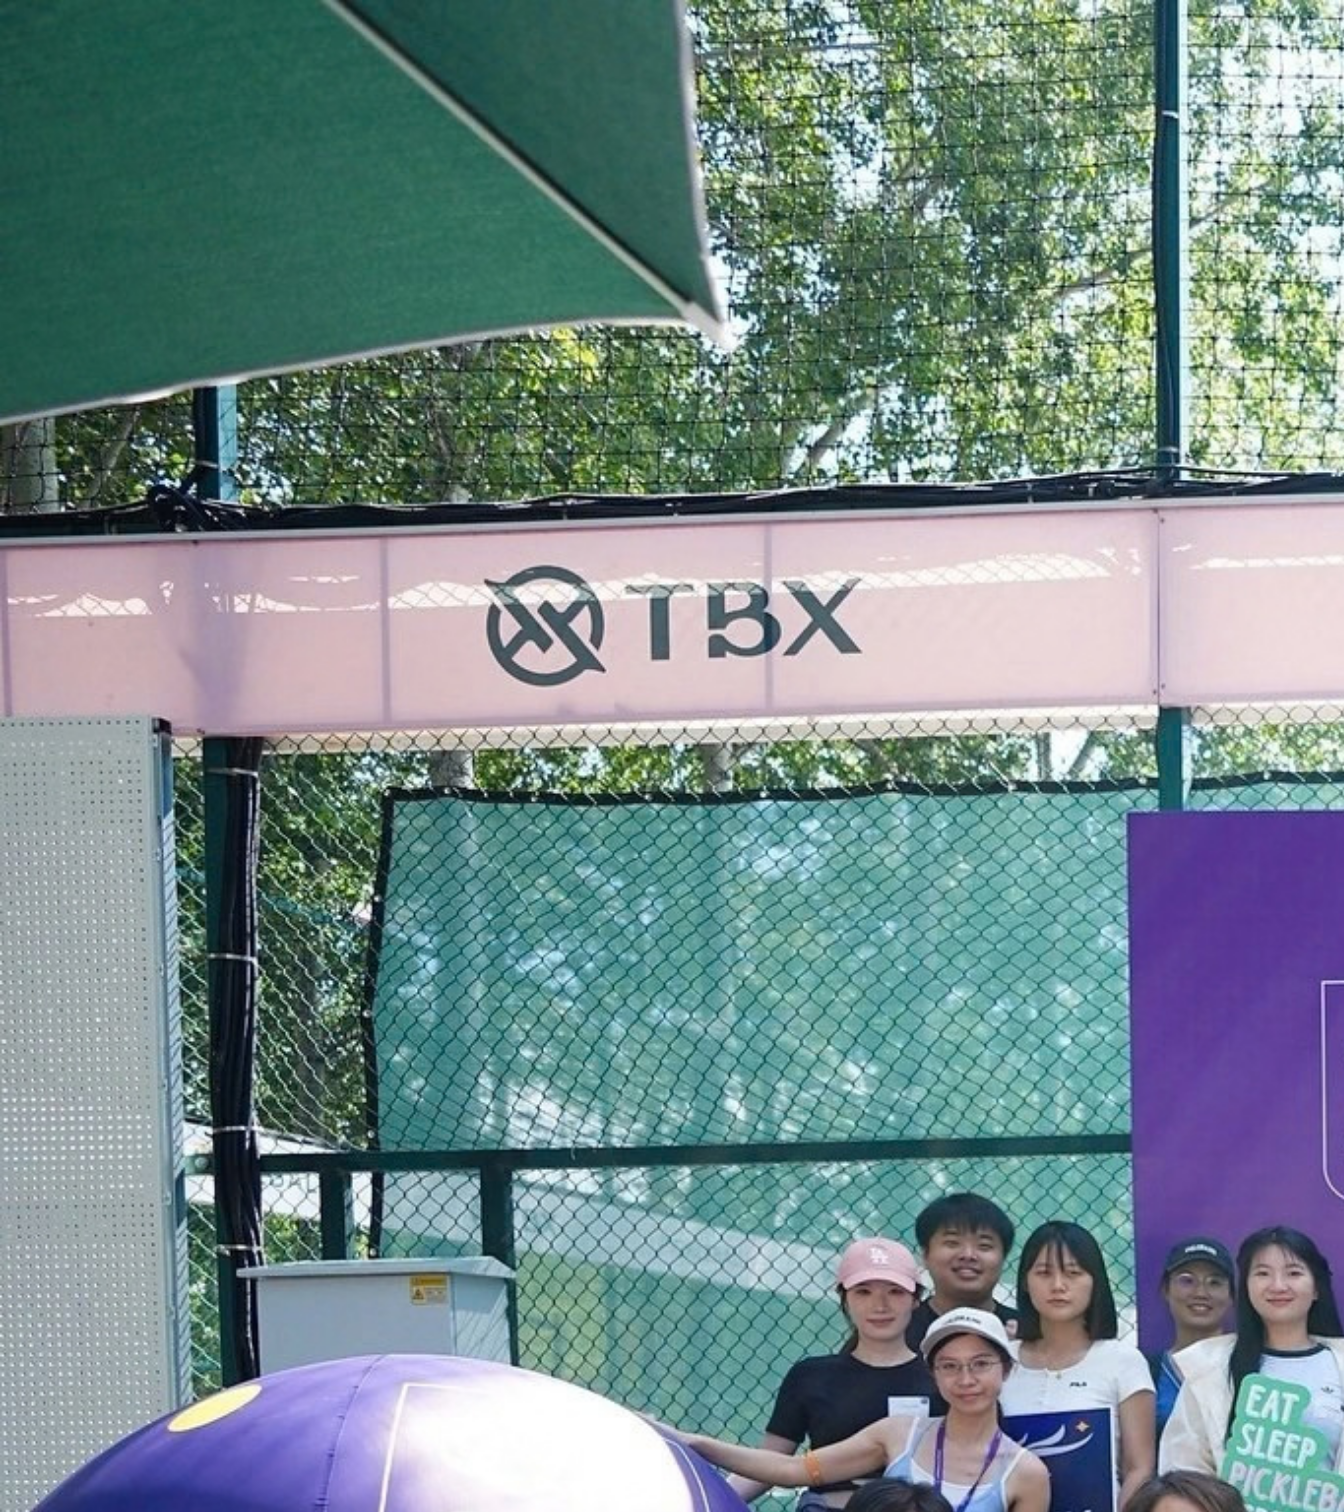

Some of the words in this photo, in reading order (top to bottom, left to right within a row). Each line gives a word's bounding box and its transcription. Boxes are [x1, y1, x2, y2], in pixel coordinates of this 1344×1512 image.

[625, 577, 863, 661] TBX
[1245, 1384, 1299, 1425] EAT
[1235, 1423, 1318, 1469] SLEEP
